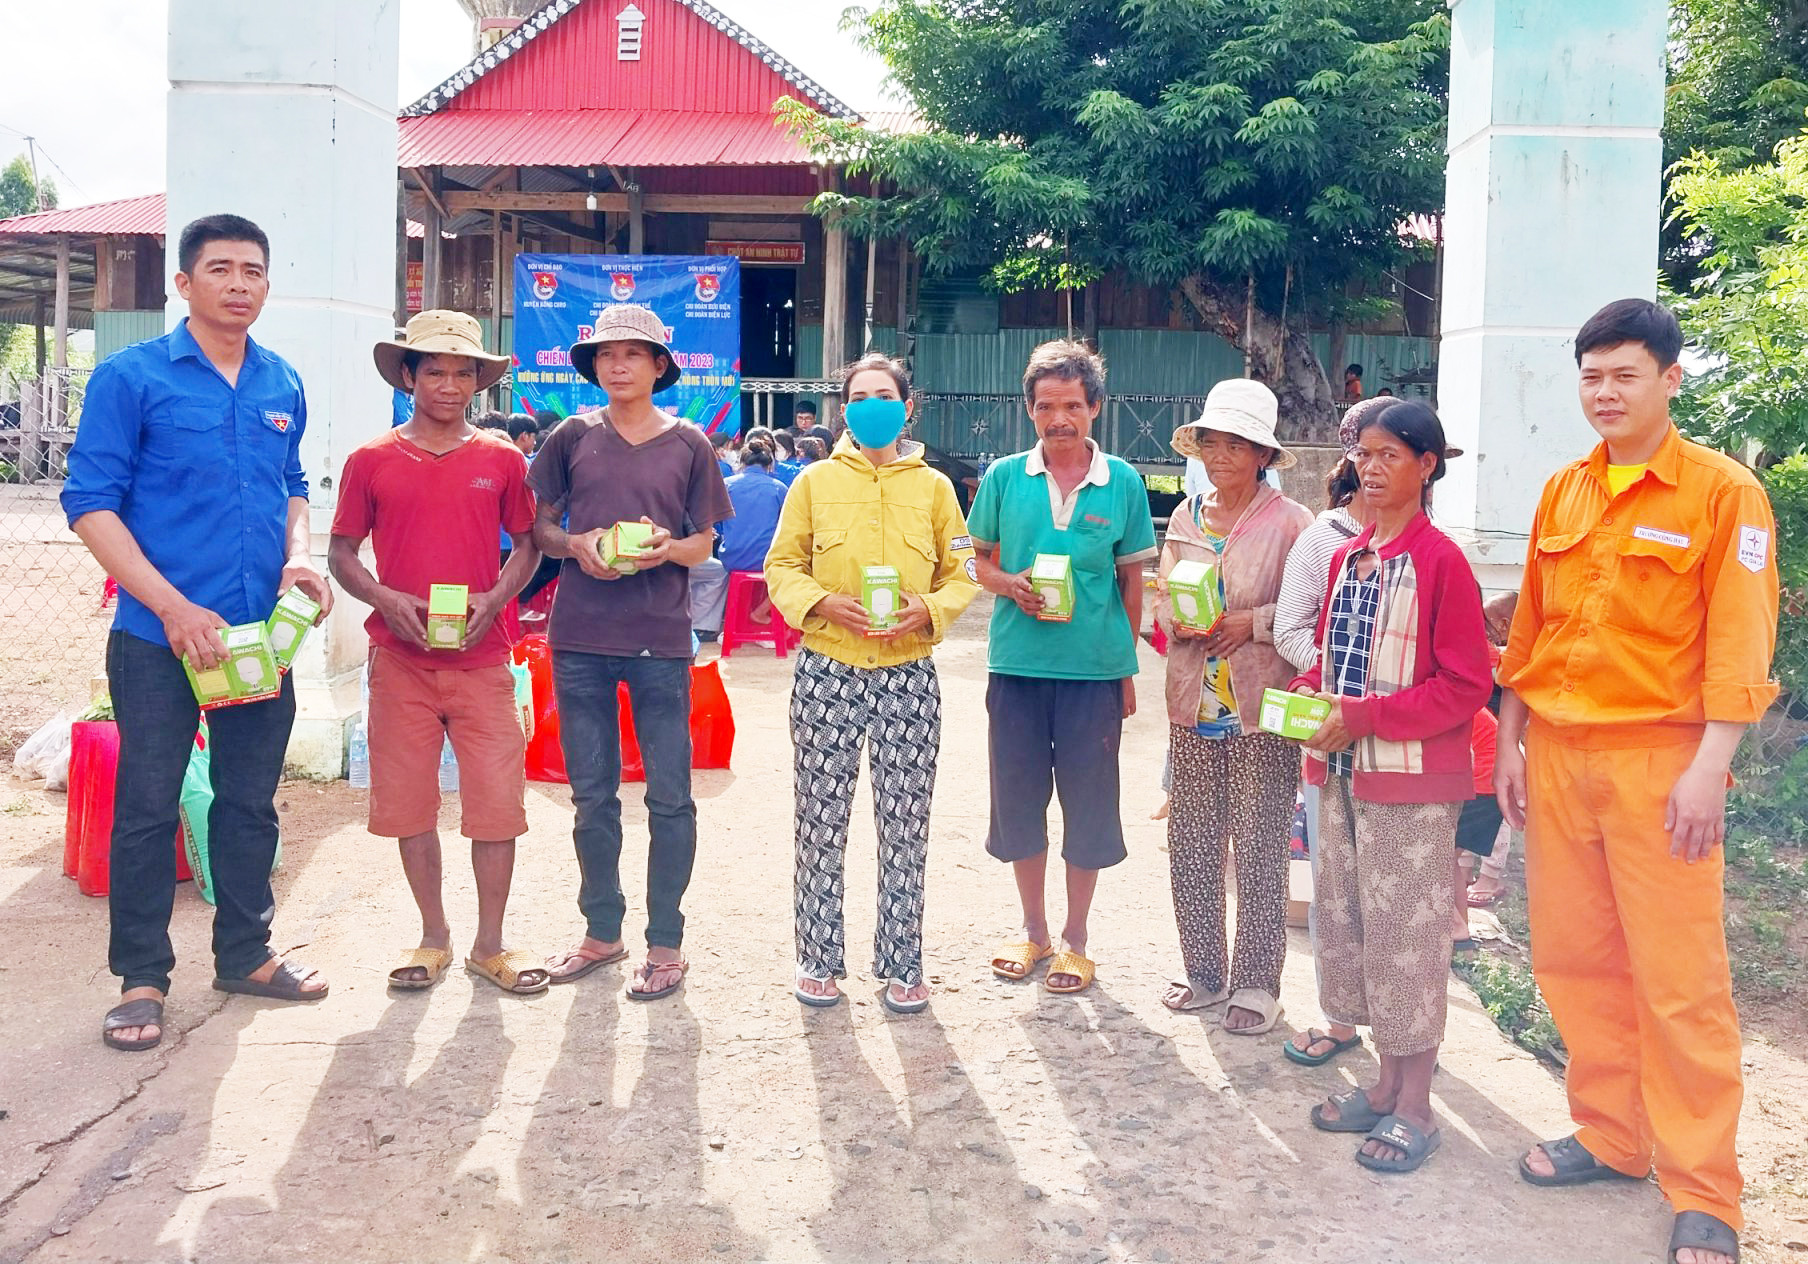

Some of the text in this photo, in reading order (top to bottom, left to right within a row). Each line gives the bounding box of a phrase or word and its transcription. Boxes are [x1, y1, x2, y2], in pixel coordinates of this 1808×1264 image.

[536, 345, 565, 366] CHIẾN
[689, 353, 714, 368] 2023
[276, 608, 309, 628] KAWACHI
[232, 645, 262, 655] AWACHI
